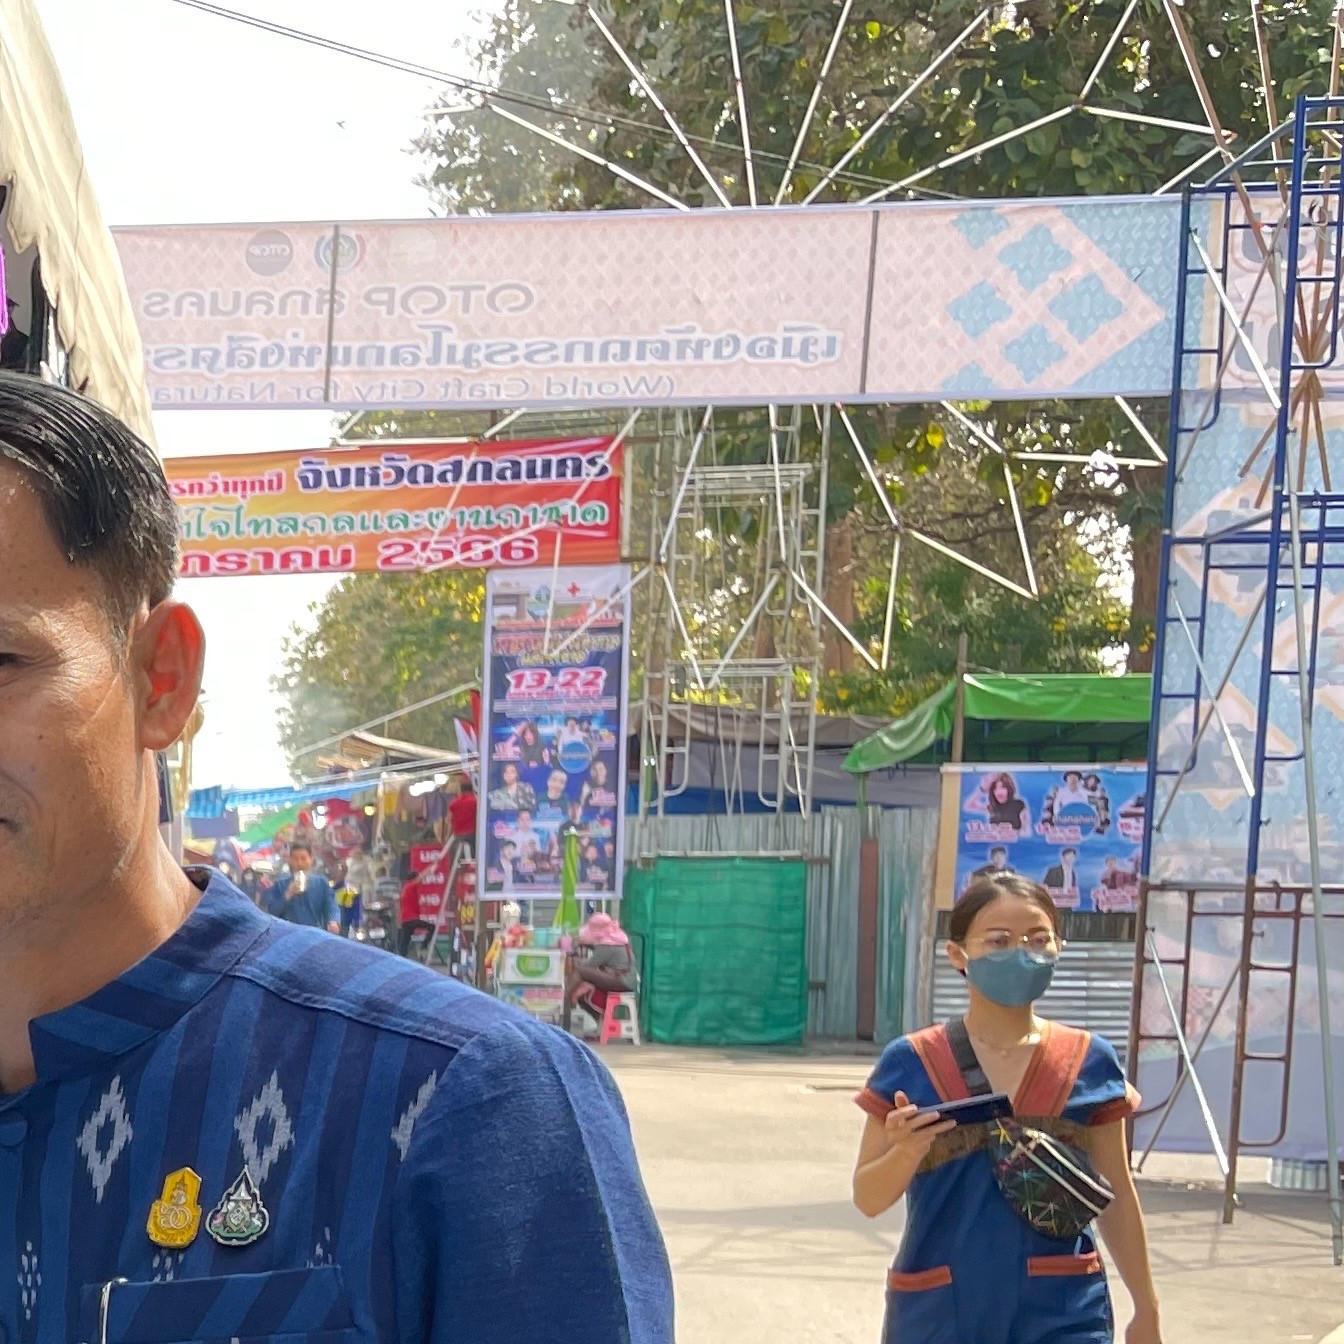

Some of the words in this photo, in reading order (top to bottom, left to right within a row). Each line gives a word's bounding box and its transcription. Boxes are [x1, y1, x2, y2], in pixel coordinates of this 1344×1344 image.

[169, 471, 284, 500] รกว่าทุกปี
[297, 453, 611, 491] จังหวัดสกลนคร
[379, 538, 537, 569] 2566
